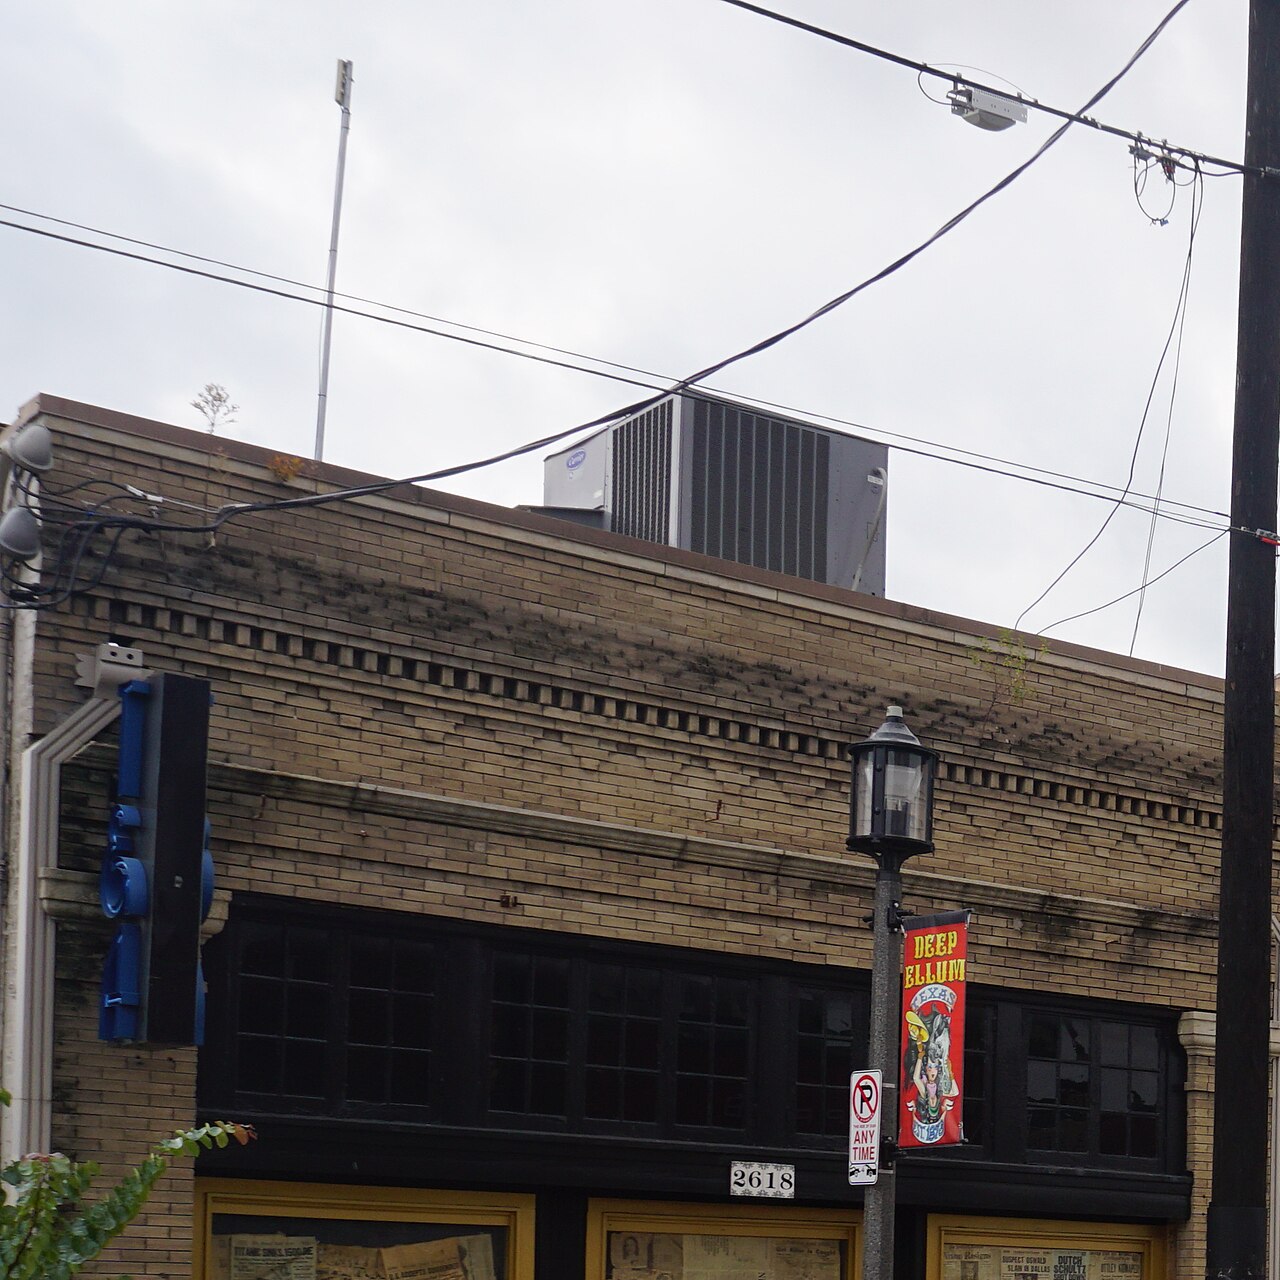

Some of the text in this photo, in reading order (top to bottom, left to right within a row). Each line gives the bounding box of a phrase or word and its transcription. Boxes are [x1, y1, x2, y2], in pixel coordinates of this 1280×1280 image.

[914, 930, 958, 960] DEEP
[904, 958, 966, 989] ELLUM
[912, 986, 956, 1007] TEXAS
[854, 1130, 875, 1144] ANY
[852, 1146, 875, 1160] TIME
[733, 1169, 793, 1190] 2618
[1058, 1256, 1083, 1265] DUTCH
[1054, 1265, 1086, 1274] SCHULTZ
